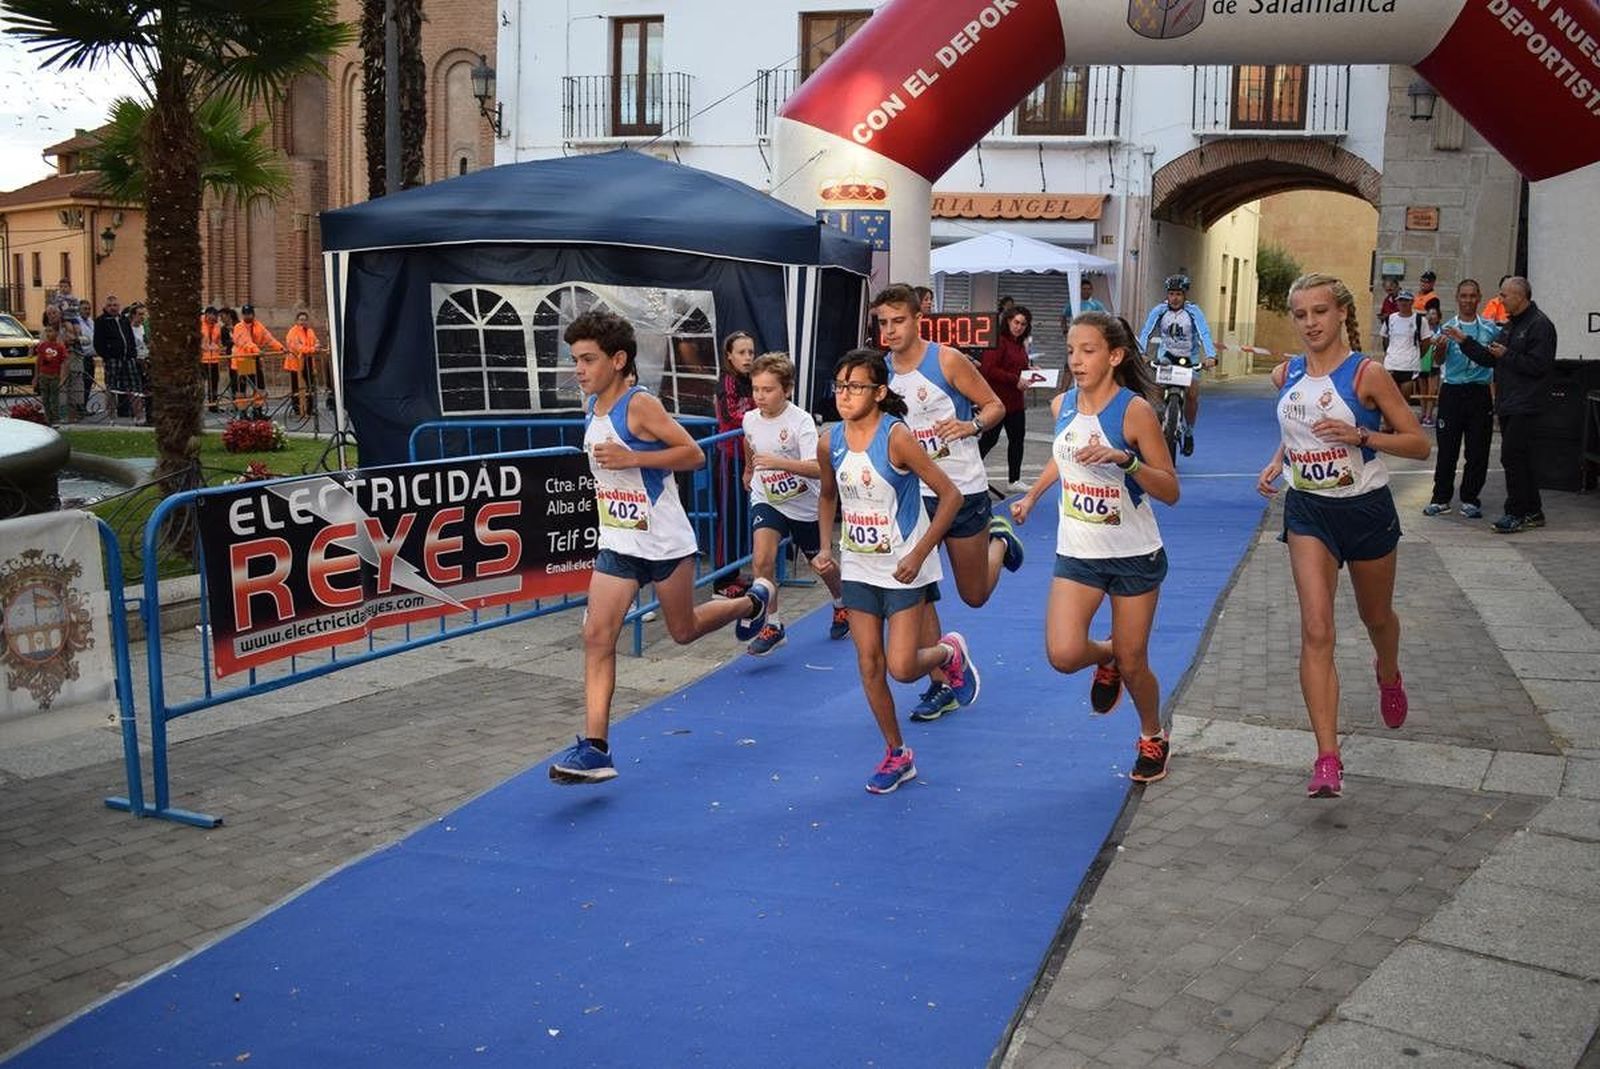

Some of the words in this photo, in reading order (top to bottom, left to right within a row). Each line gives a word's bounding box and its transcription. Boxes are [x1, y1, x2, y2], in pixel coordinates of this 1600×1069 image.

[1213, 0, 1237, 14] de
[1486, 0, 1600, 115] DEPORTIST
[852, 93, 907, 144] CON
[902, 68, 940, 99] EL
[991, 199, 1073, 213] ANGEL
[1301, 461, 1339, 481] 404
[545, 478, 576, 493] Ctra:
[771, 477, 798, 495] 405
[228, 465, 523, 536] ELECTRICIDAD
[546, 500, 575, 516] Alba
[577, 497, 592, 512] de
[608, 500, 639, 520] 402
[1072, 494, 1108, 514] 406
[547, 529, 580, 553] Telf
[849, 525, 878, 544] 403
[229, 500, 524, 633] REYES
